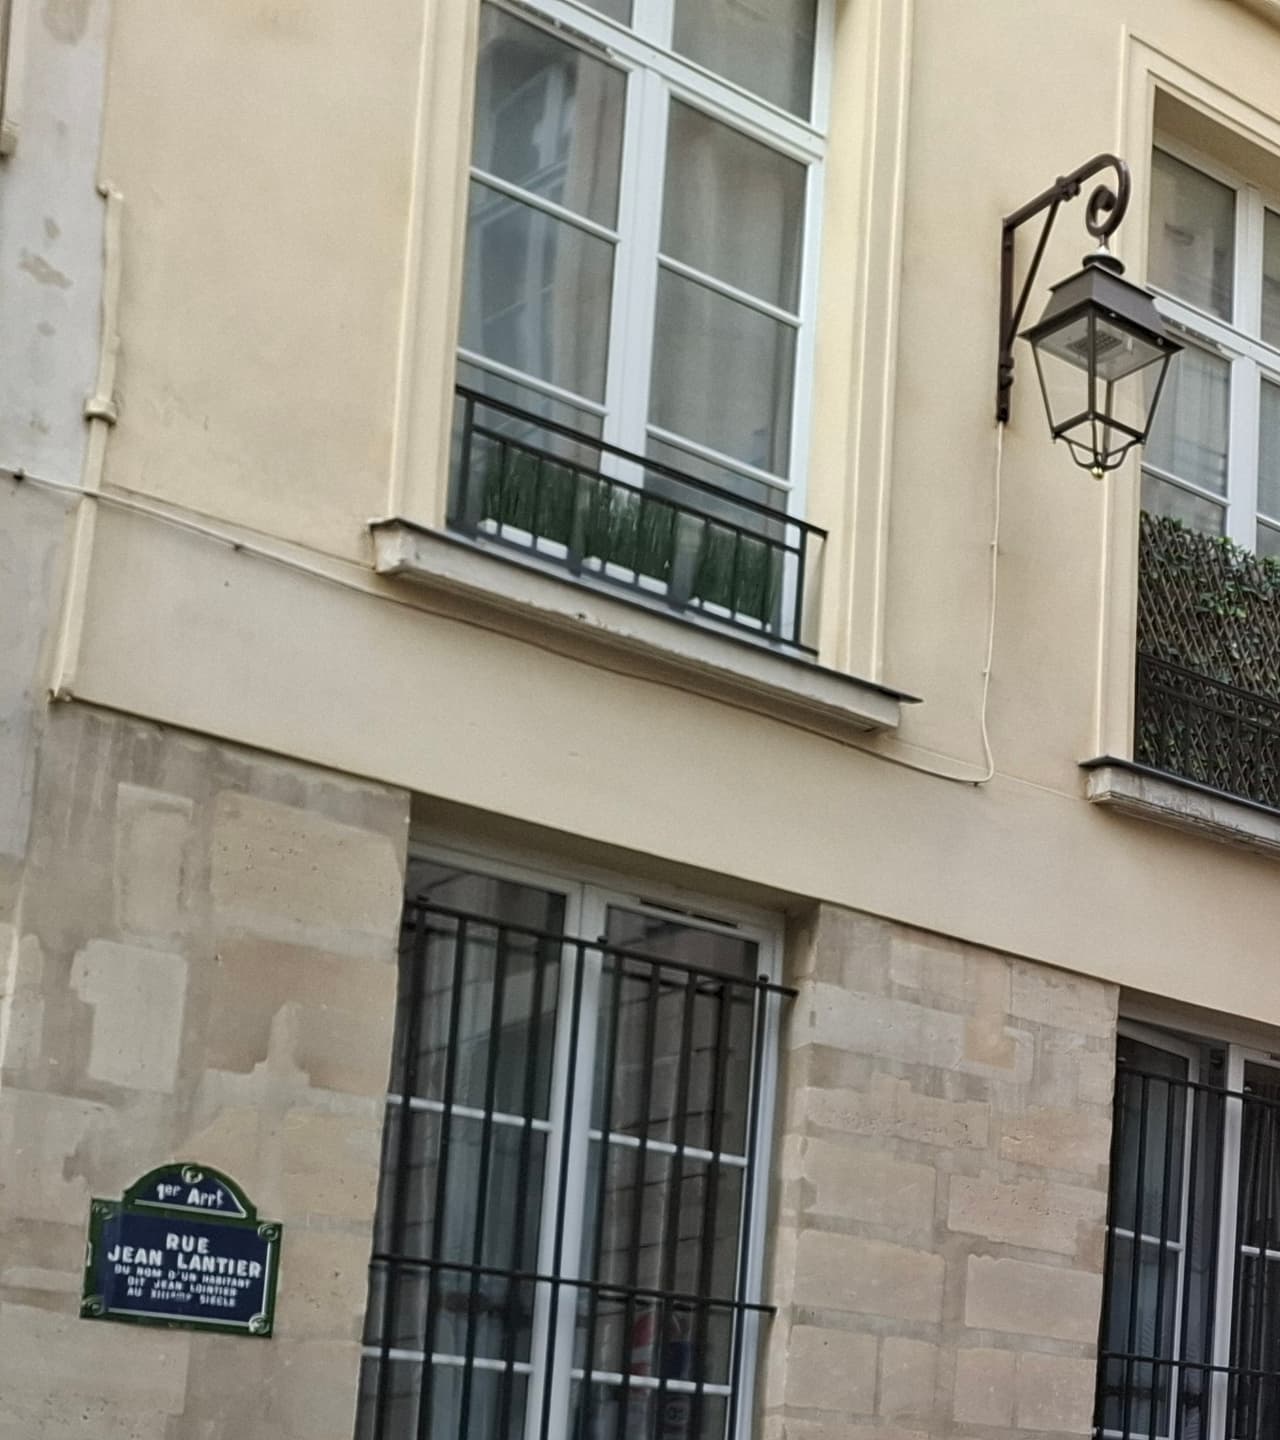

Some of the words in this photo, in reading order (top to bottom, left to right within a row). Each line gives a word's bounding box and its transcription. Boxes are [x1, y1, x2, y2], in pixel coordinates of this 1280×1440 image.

[165, 1233, 210, 1254] RUE
[107, 1244, 163, 1266] JEAN
[176, 1253, 262, 1278] LANTIER
[114, 1264, 130, 1275] DU
[136, 1266, 162, 1278] NOM
[202, 1274, 251, 1288] HABITANT
[127, 1275, 146, 1287] DIT
[153, 1280, 183, 1291] JEAN
[126, 1286, 143, 1298] AU
